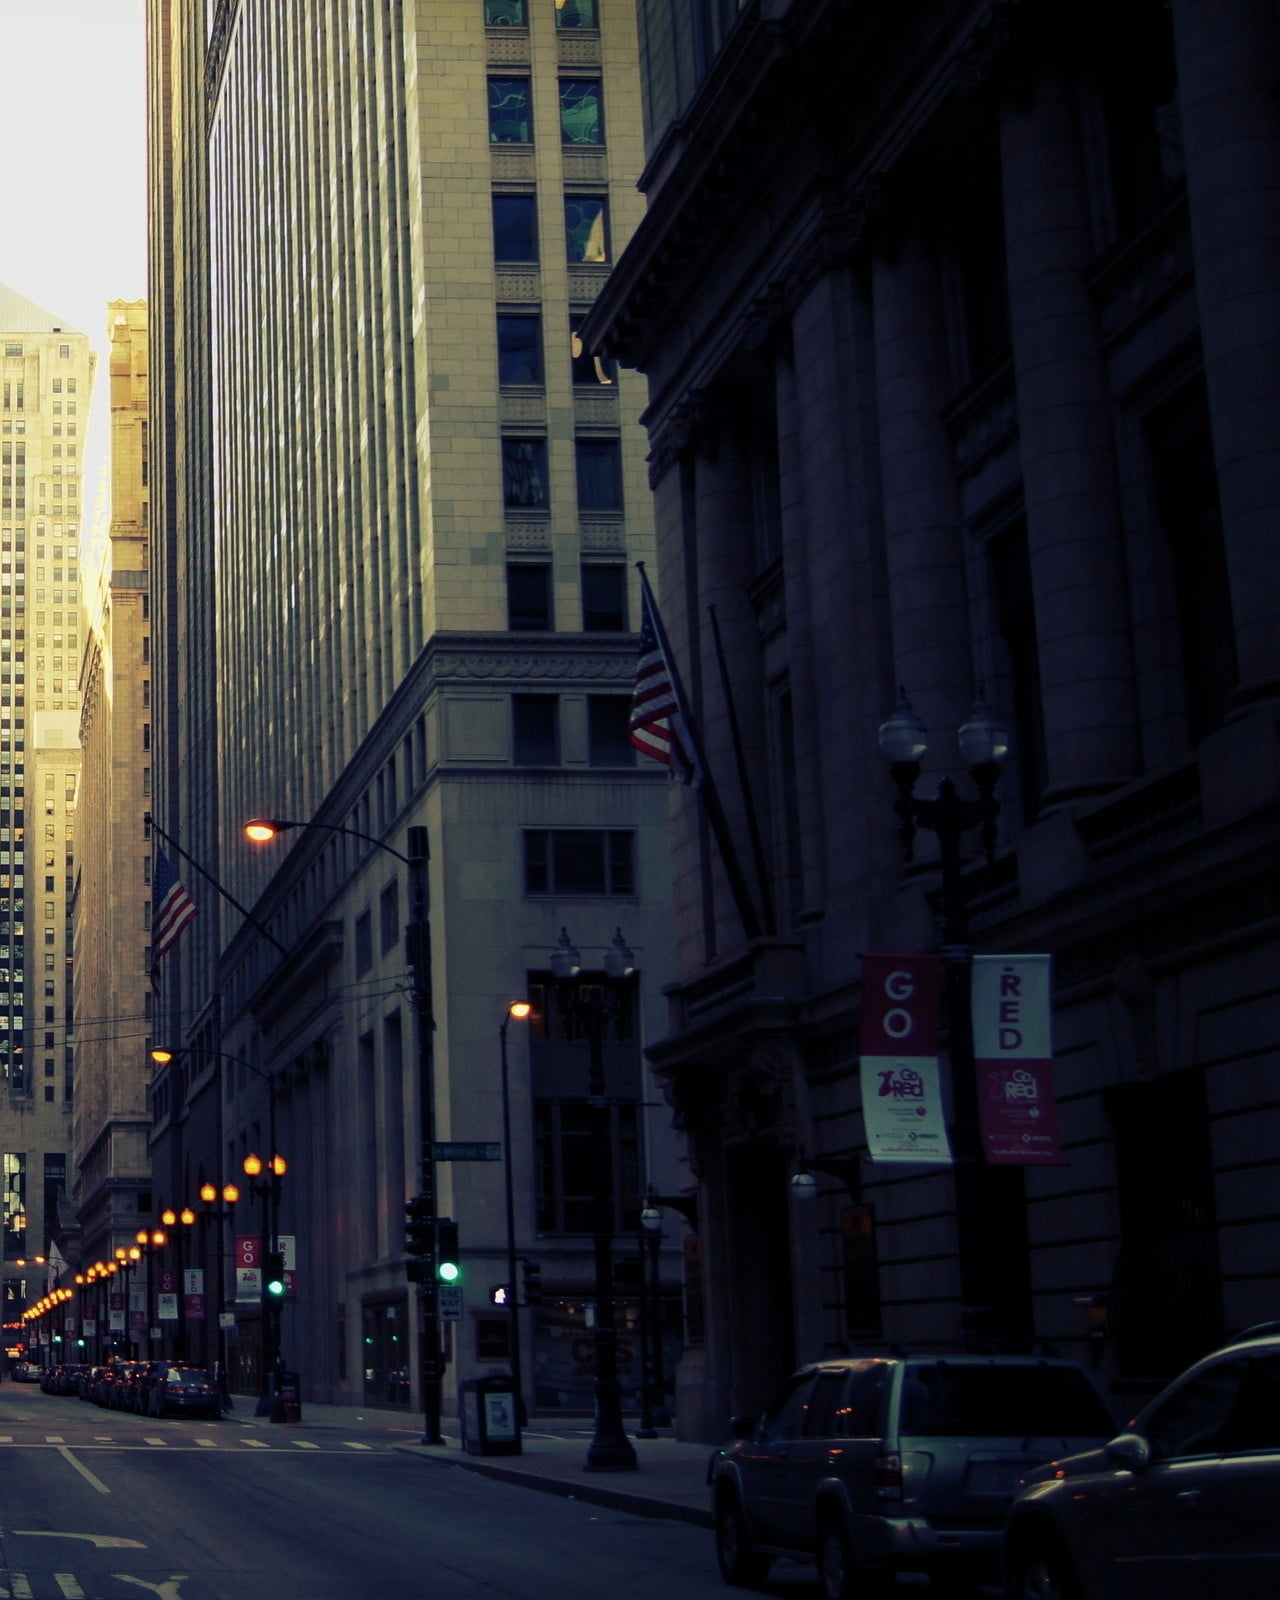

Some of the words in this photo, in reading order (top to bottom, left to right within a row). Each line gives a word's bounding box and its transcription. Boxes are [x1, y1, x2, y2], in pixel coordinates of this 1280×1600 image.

[883, 971, 914, 1038] GO
[999, 975, 1023, 1050] RED
[900, 1068, 918, 1081] Go
[892, 1078, 924, 1097] Red
[1004, 1077, 1038, 1099] Red
[243, 1241, 254, 1263] GO
[163, 1273, 171, 1290] GO
[440, 1288, 459, 1298] ONE
[440, 1299, 459, 1308] WAY
[573, 1341, 634, 1362] CS
